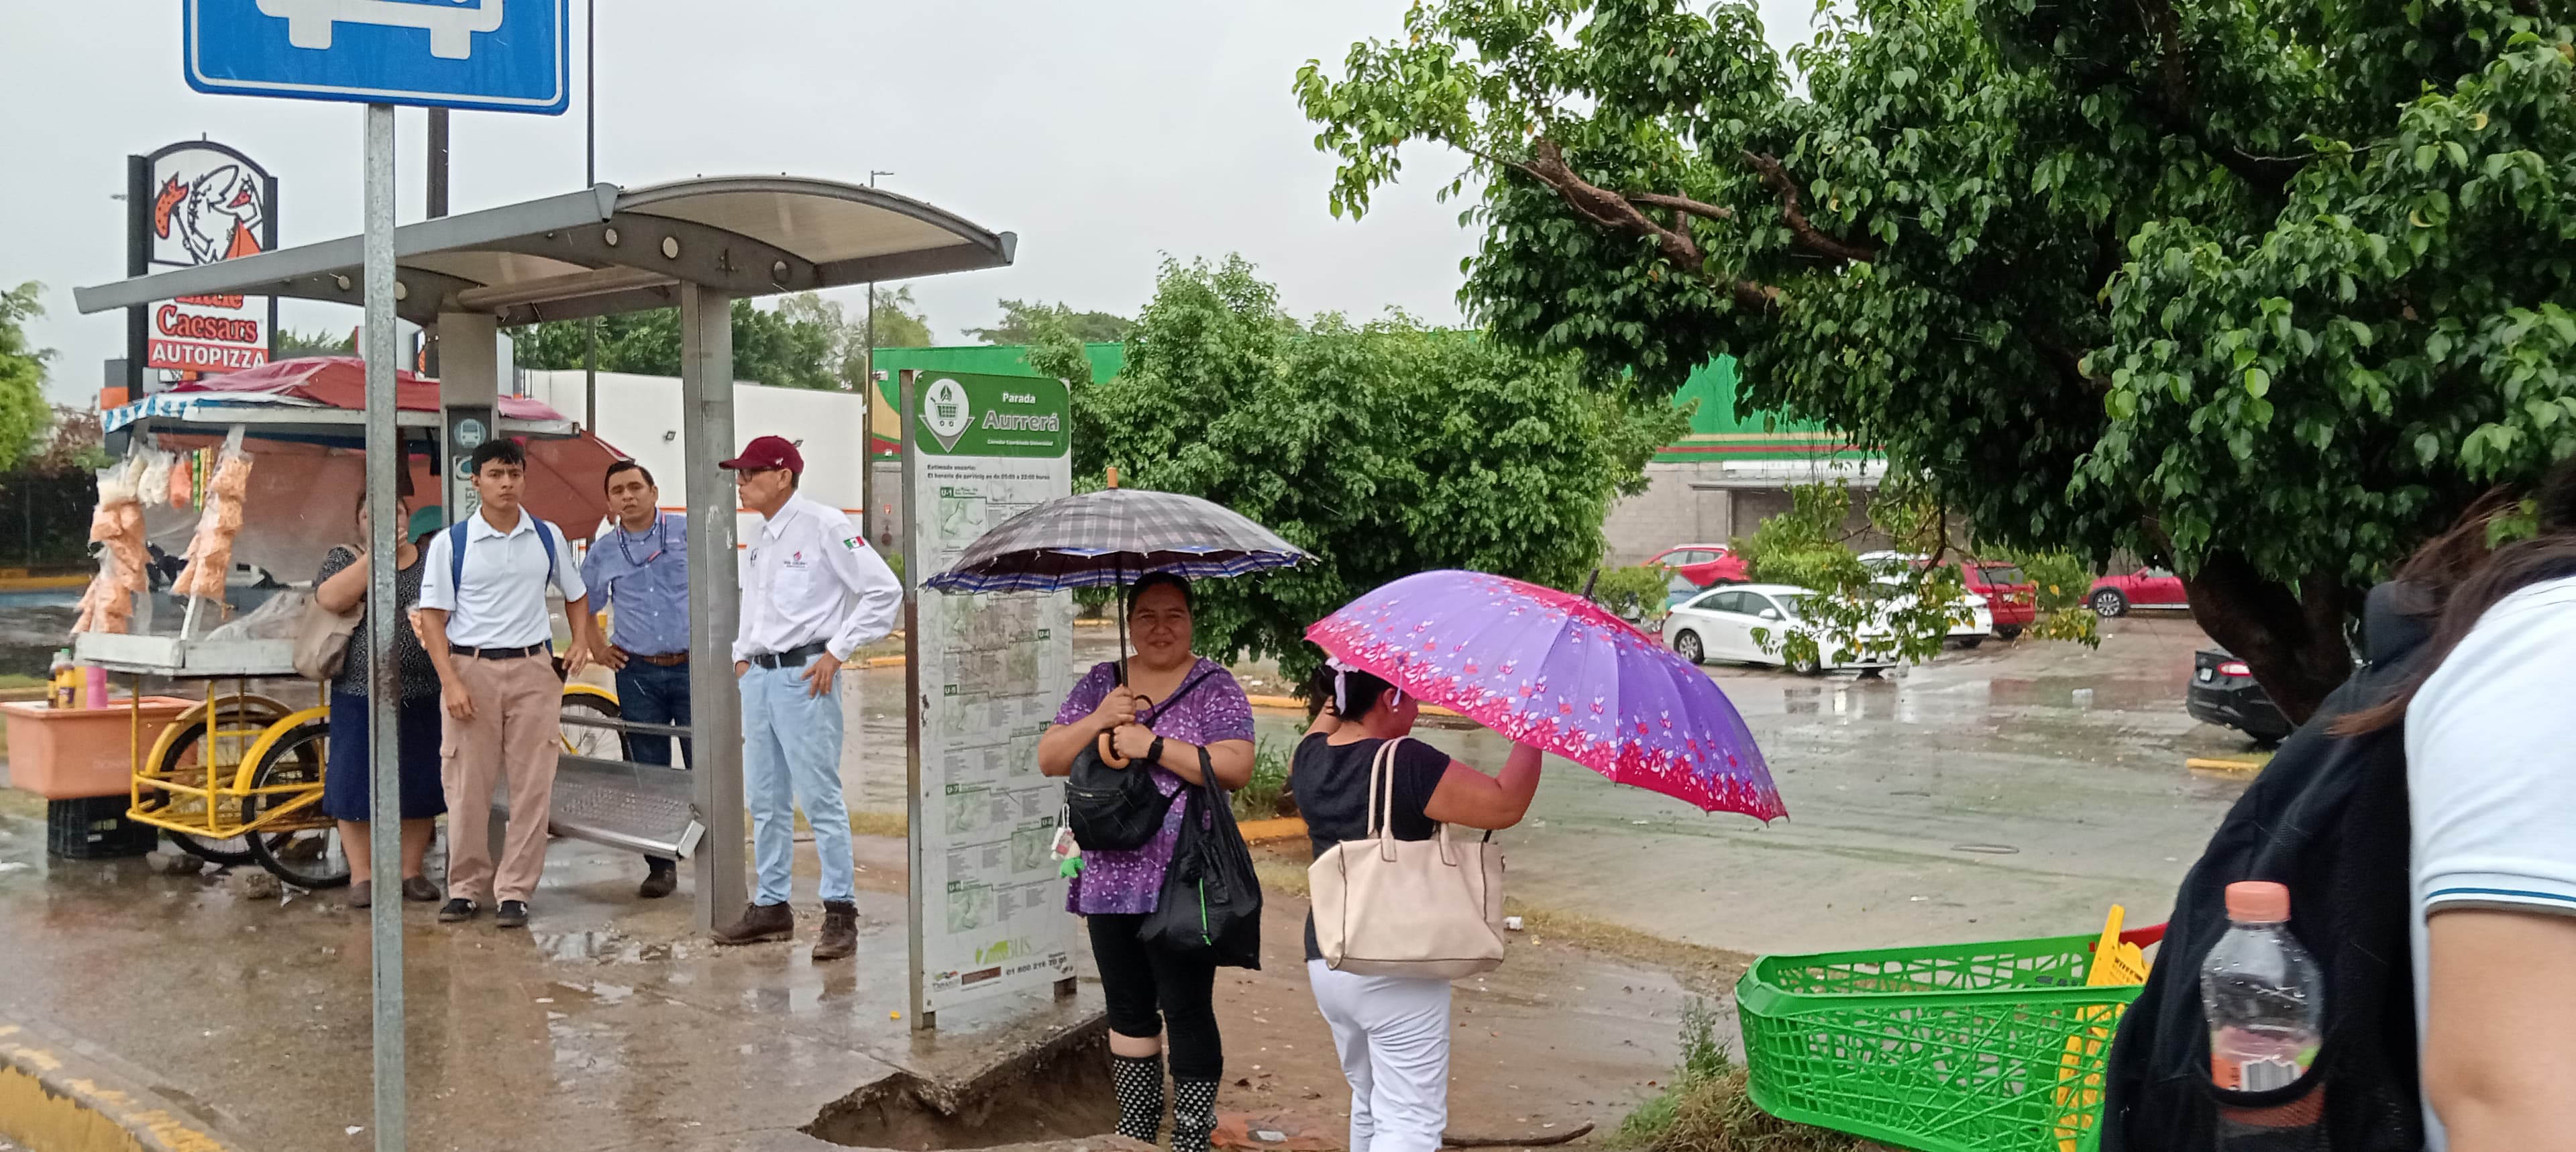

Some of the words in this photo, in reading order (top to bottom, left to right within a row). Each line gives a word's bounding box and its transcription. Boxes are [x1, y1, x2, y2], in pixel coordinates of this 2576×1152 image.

[156, 304, 258, 344] Caesars
[152, 342, 265, 368] AUTOPIZZA
[1002, 391, 1036, 404] Parada
[981, 409, 1060, 432] Aurrerá
